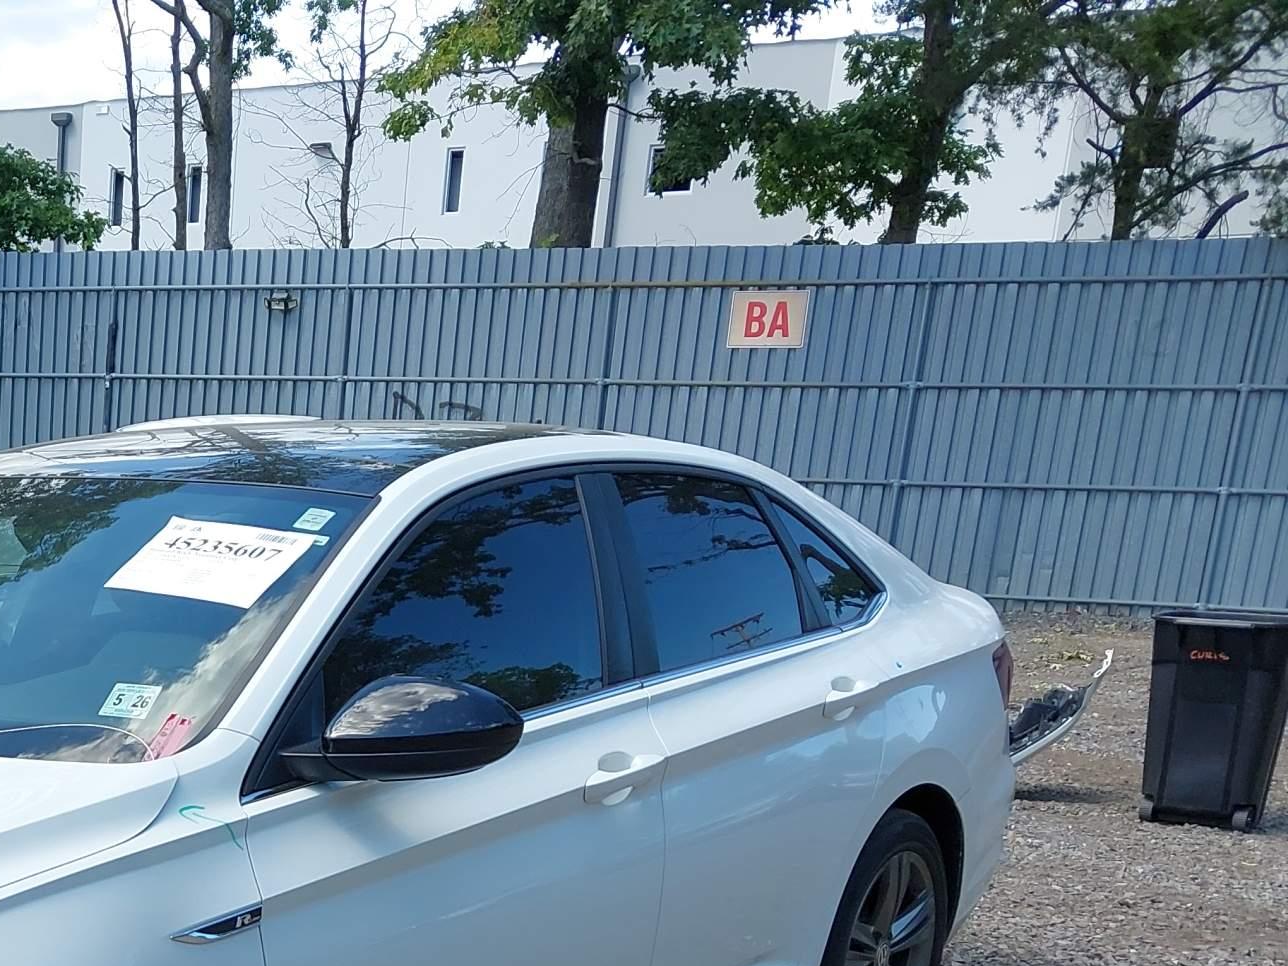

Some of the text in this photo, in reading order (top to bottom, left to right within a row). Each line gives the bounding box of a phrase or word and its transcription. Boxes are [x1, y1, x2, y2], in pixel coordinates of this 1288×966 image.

[743, 301, 790, 338] BA
[164, 536, 283, 562] 45235607
[113, 693, 151, 709] 5 26
